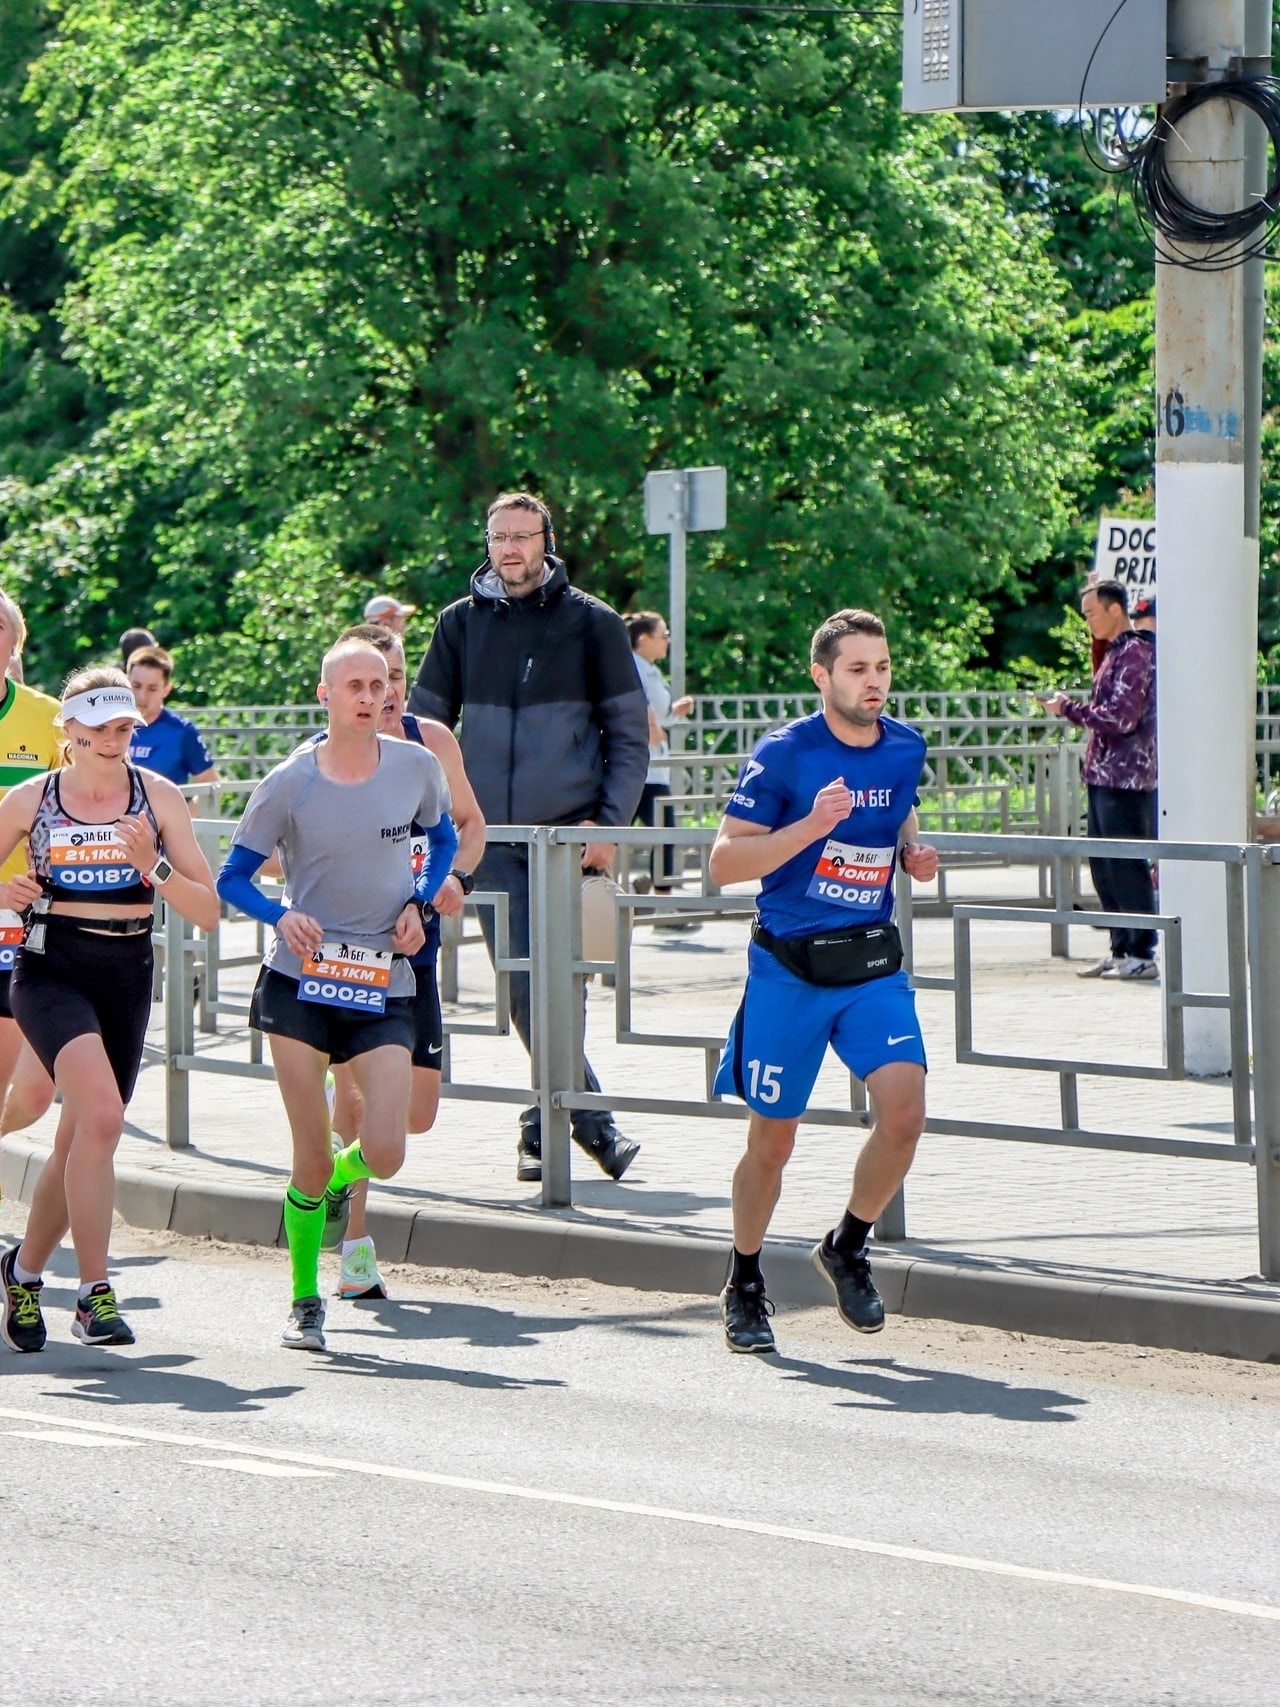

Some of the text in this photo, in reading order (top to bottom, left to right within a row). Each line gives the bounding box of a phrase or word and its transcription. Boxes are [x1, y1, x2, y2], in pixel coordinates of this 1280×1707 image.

[1108, 527, 1156, 552] DOC
[868, 789, 892, 808] БЕГ
[84, 831, 112, 842] ЗА БЕГ
[854, 853, 878, 863] ЗА БЕГ
[60, 869, 135, 884] 00187
[838, 867, 879, 881] 10КМ
[818, 881, 881, 904] 10087
[337, 948, 365, 962] ЗА БЕГ
[867, 958, 888, 969] SPORT
[316, 963, 376, 982] 21,1КМ
[303, 980, 383, 1007] 00022
[748, 1059, 784, 1104] 15
